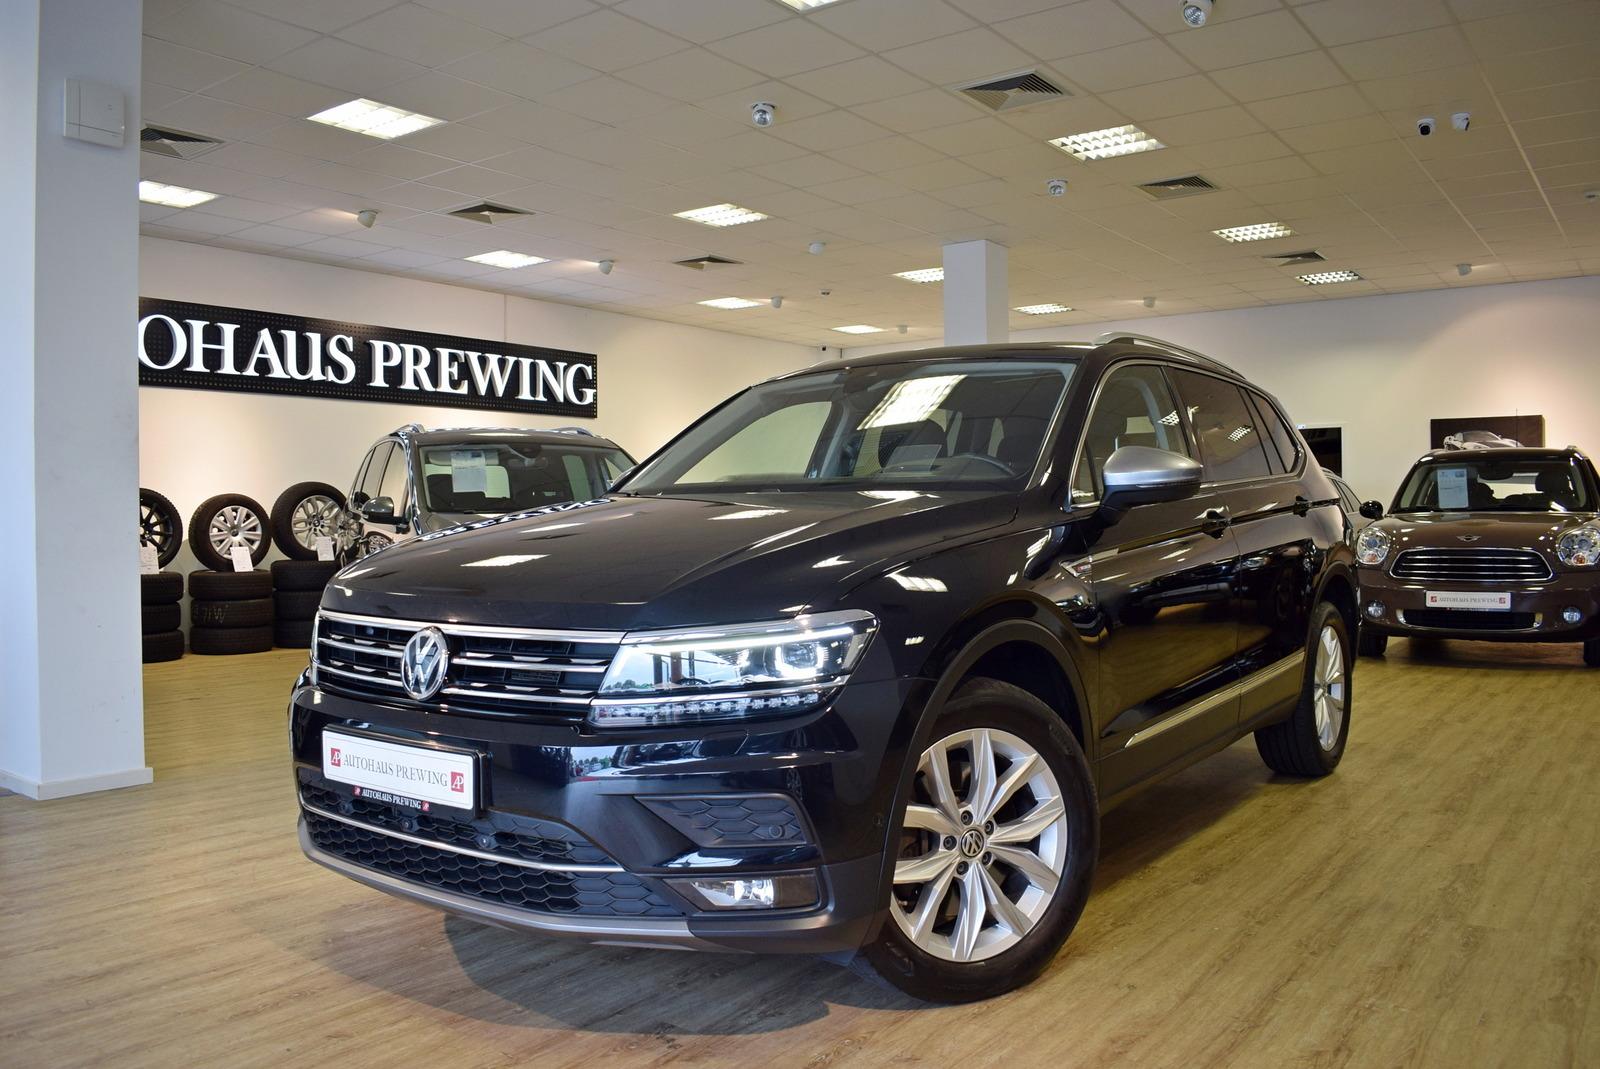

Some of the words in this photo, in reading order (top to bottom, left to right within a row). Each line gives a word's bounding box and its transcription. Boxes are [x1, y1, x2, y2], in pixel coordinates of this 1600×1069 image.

[366, 338, 597, 406] PREWING
[343, 753, 394, 776] AUTOHAUS
[395, 763, 448, 787] PREWING
[361, 788, 393, 803] AUTOHAUS
[392, 795, 422, 810] PREWING
